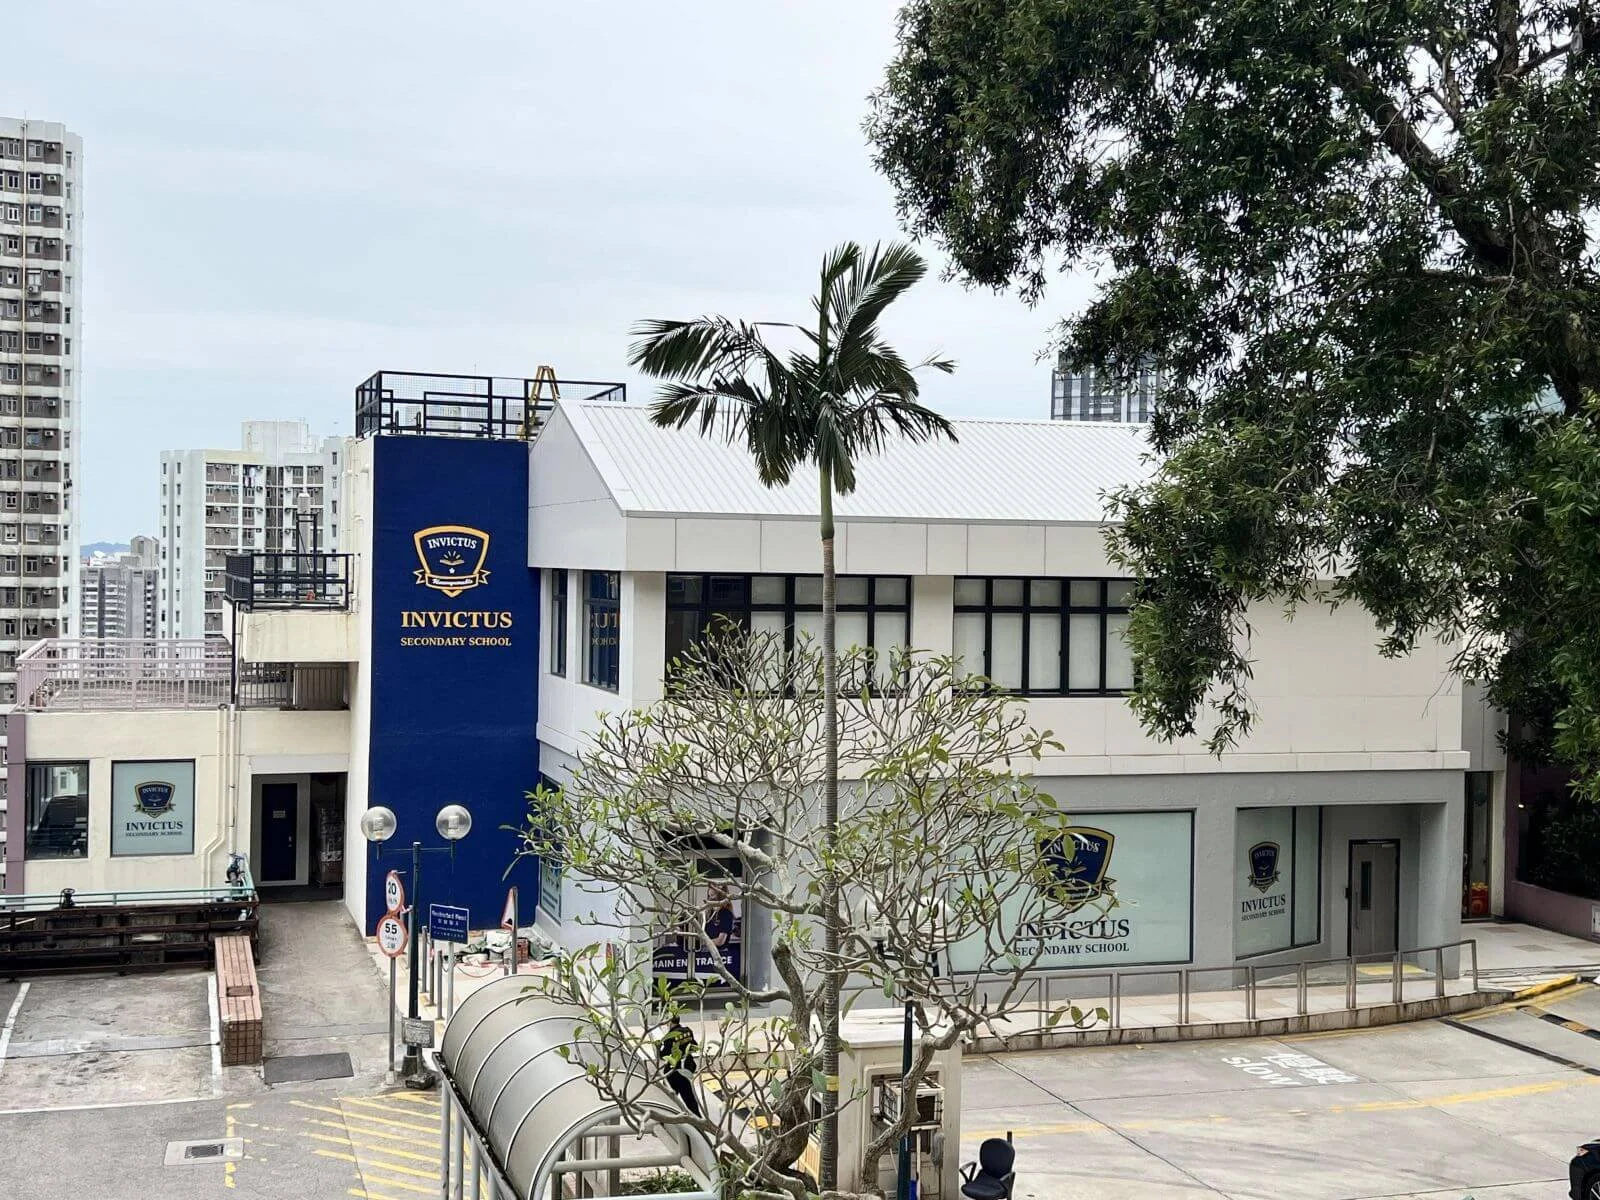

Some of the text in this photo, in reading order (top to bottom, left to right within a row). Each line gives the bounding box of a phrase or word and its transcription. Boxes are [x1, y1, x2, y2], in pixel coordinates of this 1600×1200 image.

[427, 536, 477, 549] INVICTUS
[400, 611, 512, 628] INVICTUS
[400, 637, 512, 646] SECONDARY SCHOOL
[126, 820, 183, 831] INVICTUS
[1050, 840, 1100, 852] INCTUS
[1241, 894, 1286, 913] INVICTUS
[1085, 943, 1129, 953] SCHOOL
